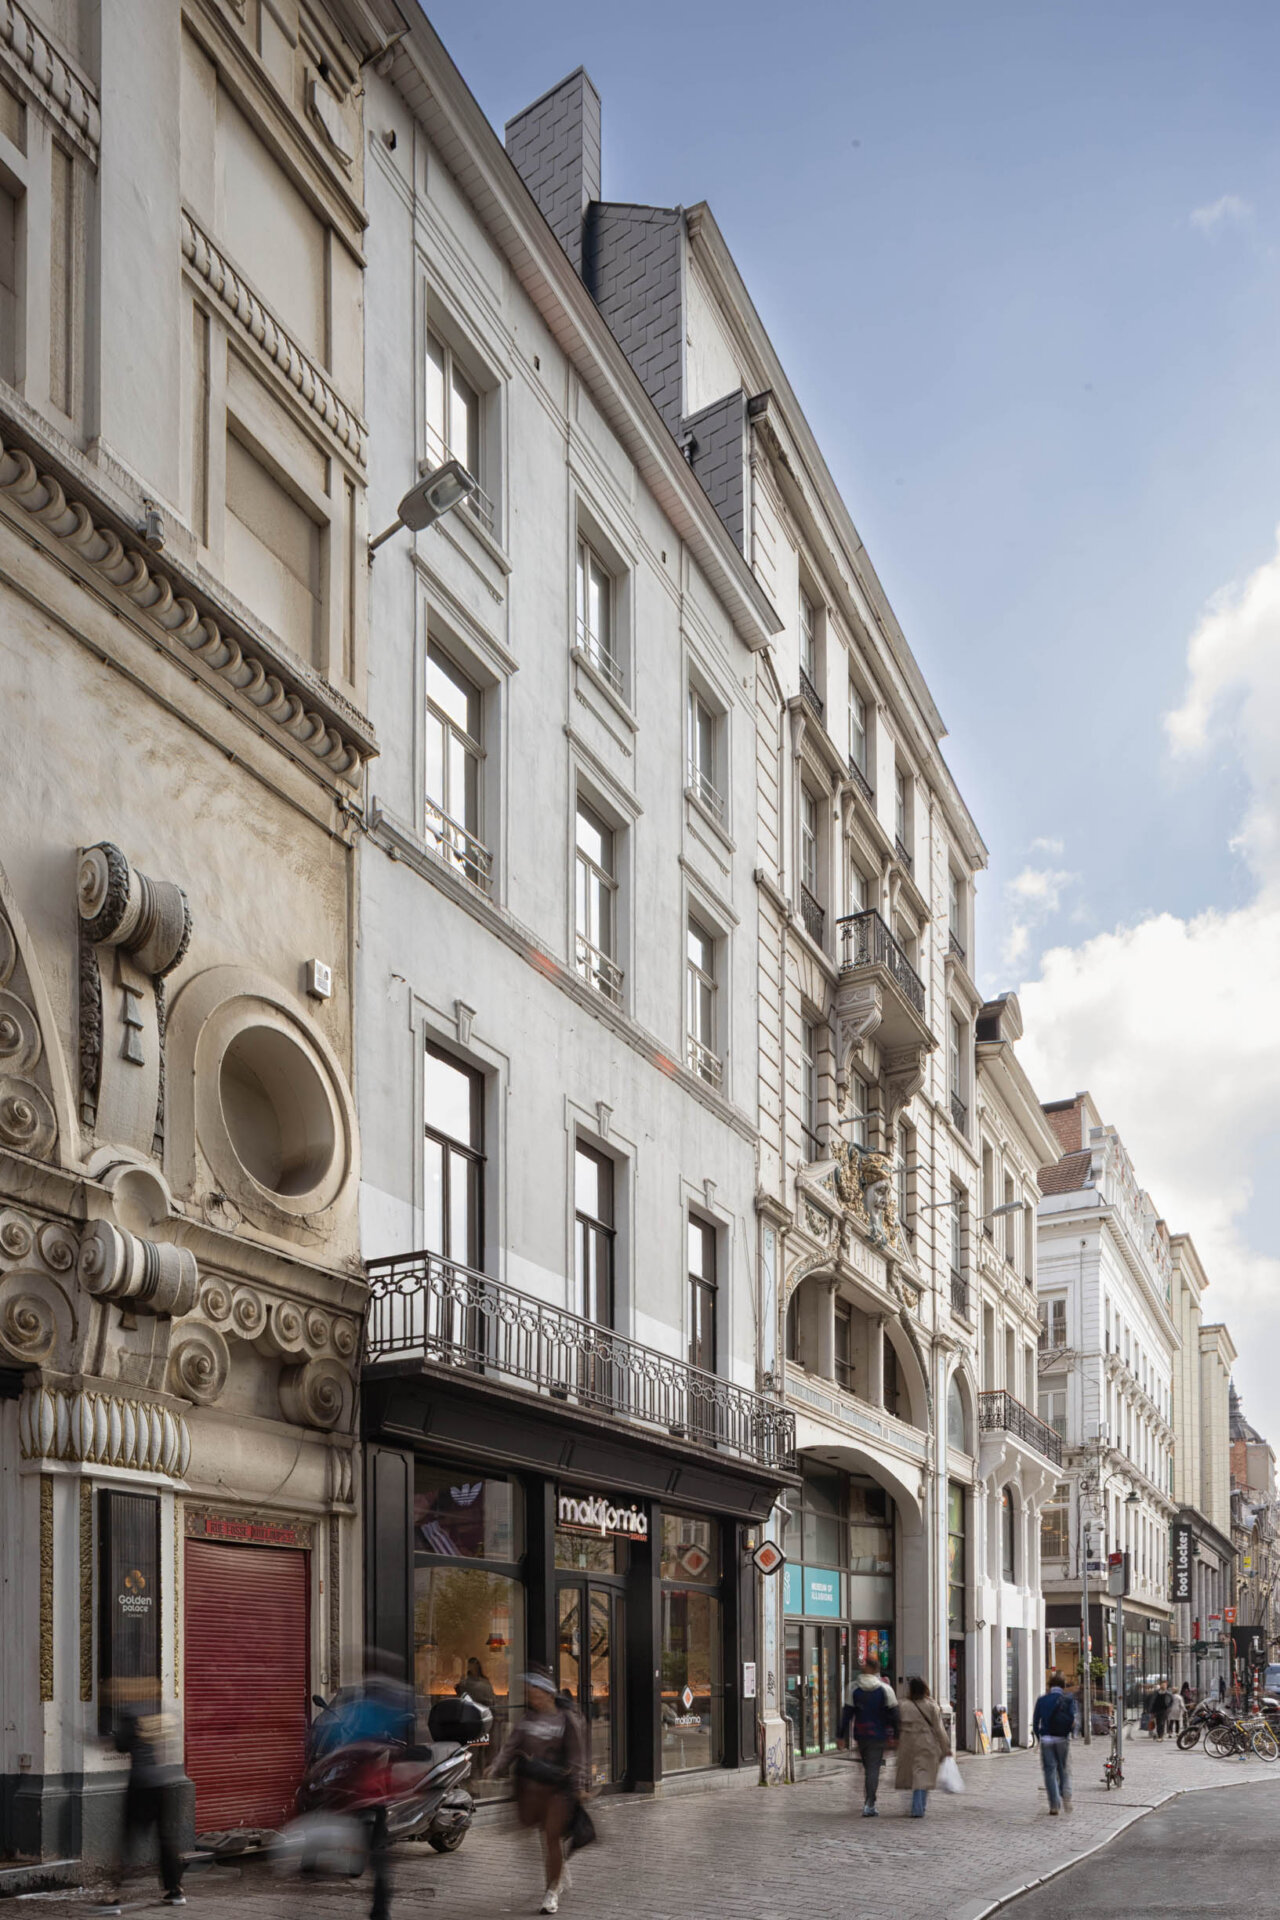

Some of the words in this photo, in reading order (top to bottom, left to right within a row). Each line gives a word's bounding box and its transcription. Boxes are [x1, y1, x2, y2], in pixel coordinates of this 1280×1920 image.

[1177, 1531, 1188, 1569] Locker
[1177, 1571, 1188, 1596] Foot
[119, 1595, 152, 1605] Golden
